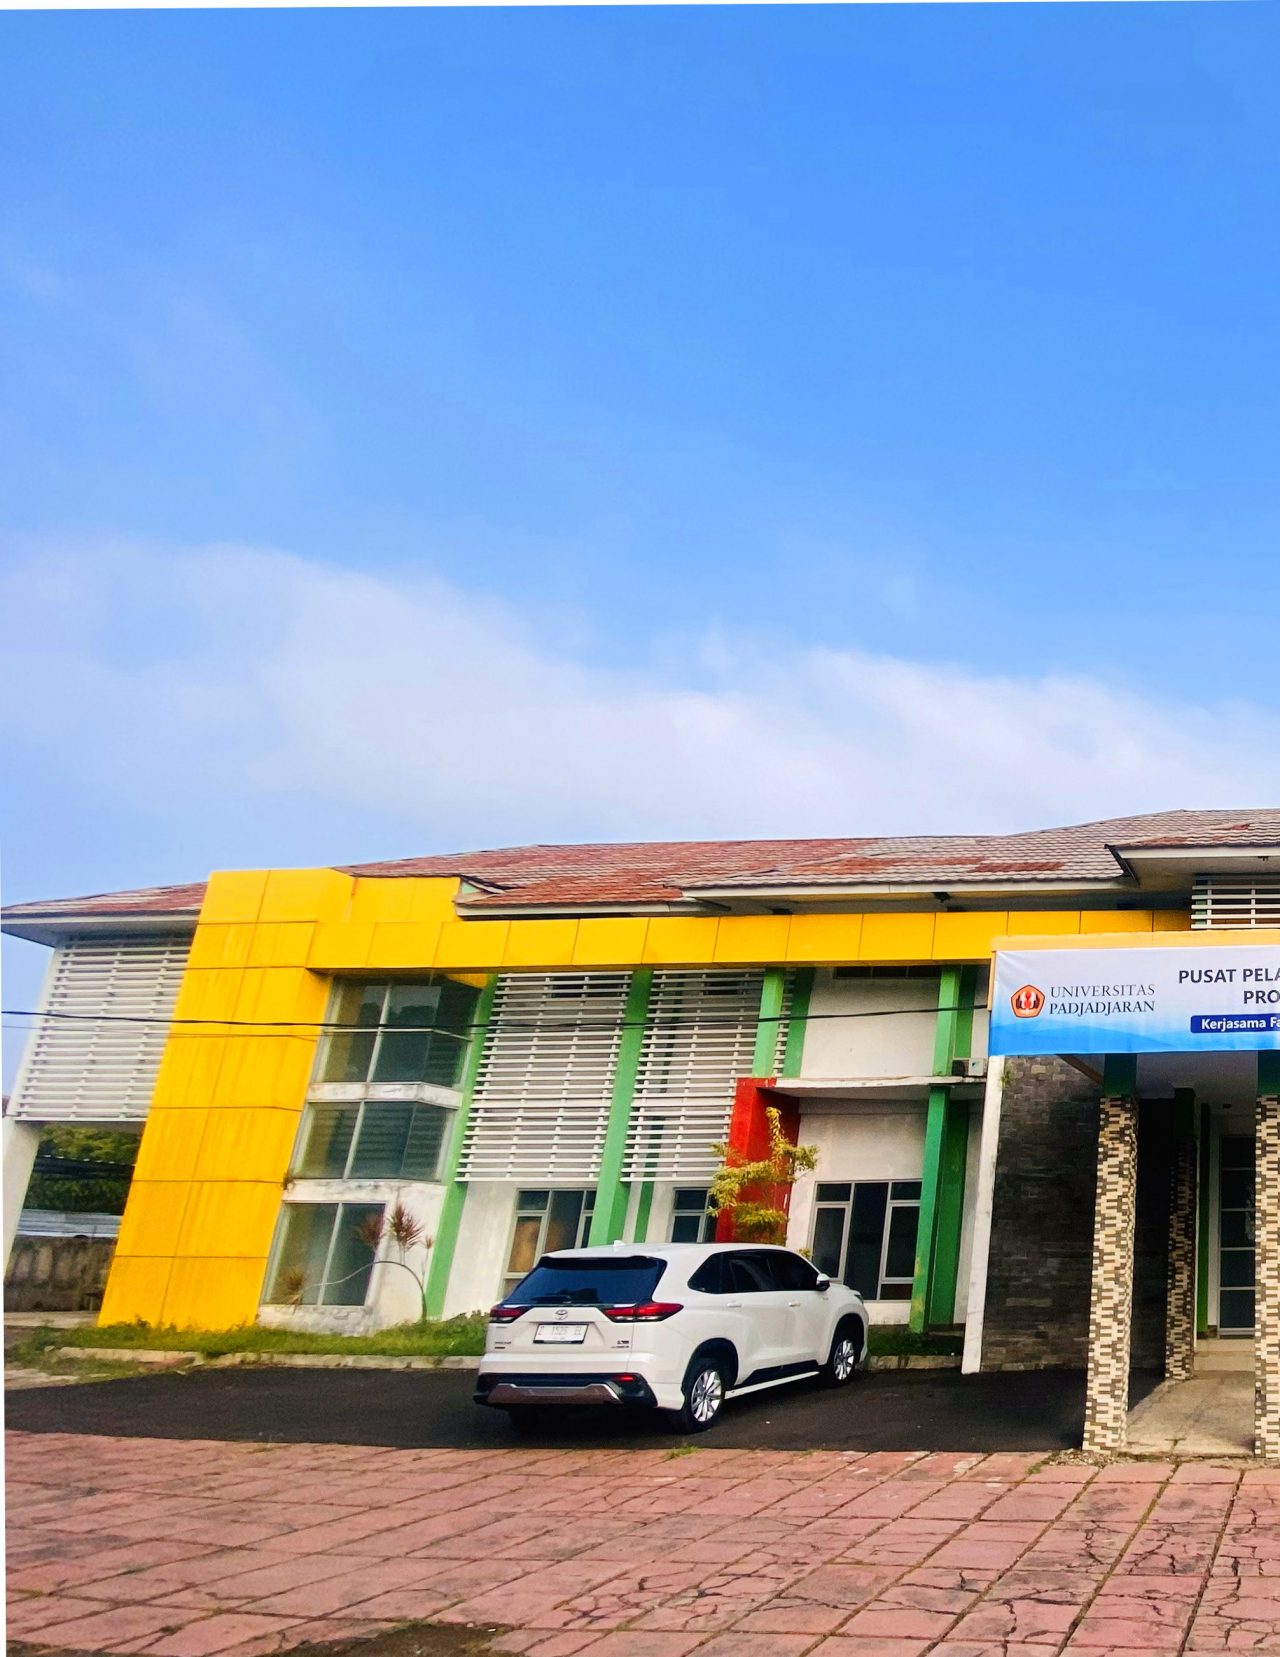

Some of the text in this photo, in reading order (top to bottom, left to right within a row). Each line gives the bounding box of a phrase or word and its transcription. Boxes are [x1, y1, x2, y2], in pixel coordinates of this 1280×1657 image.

[1178, 969, 1237, 983] PUSAT
[1050, 983, 1155, 999] UNIVERSITAS
[1049, 1000, 1155, 1017] PADJADJARAN
[1201, 1018, 1267, 1031] Kerjasama
